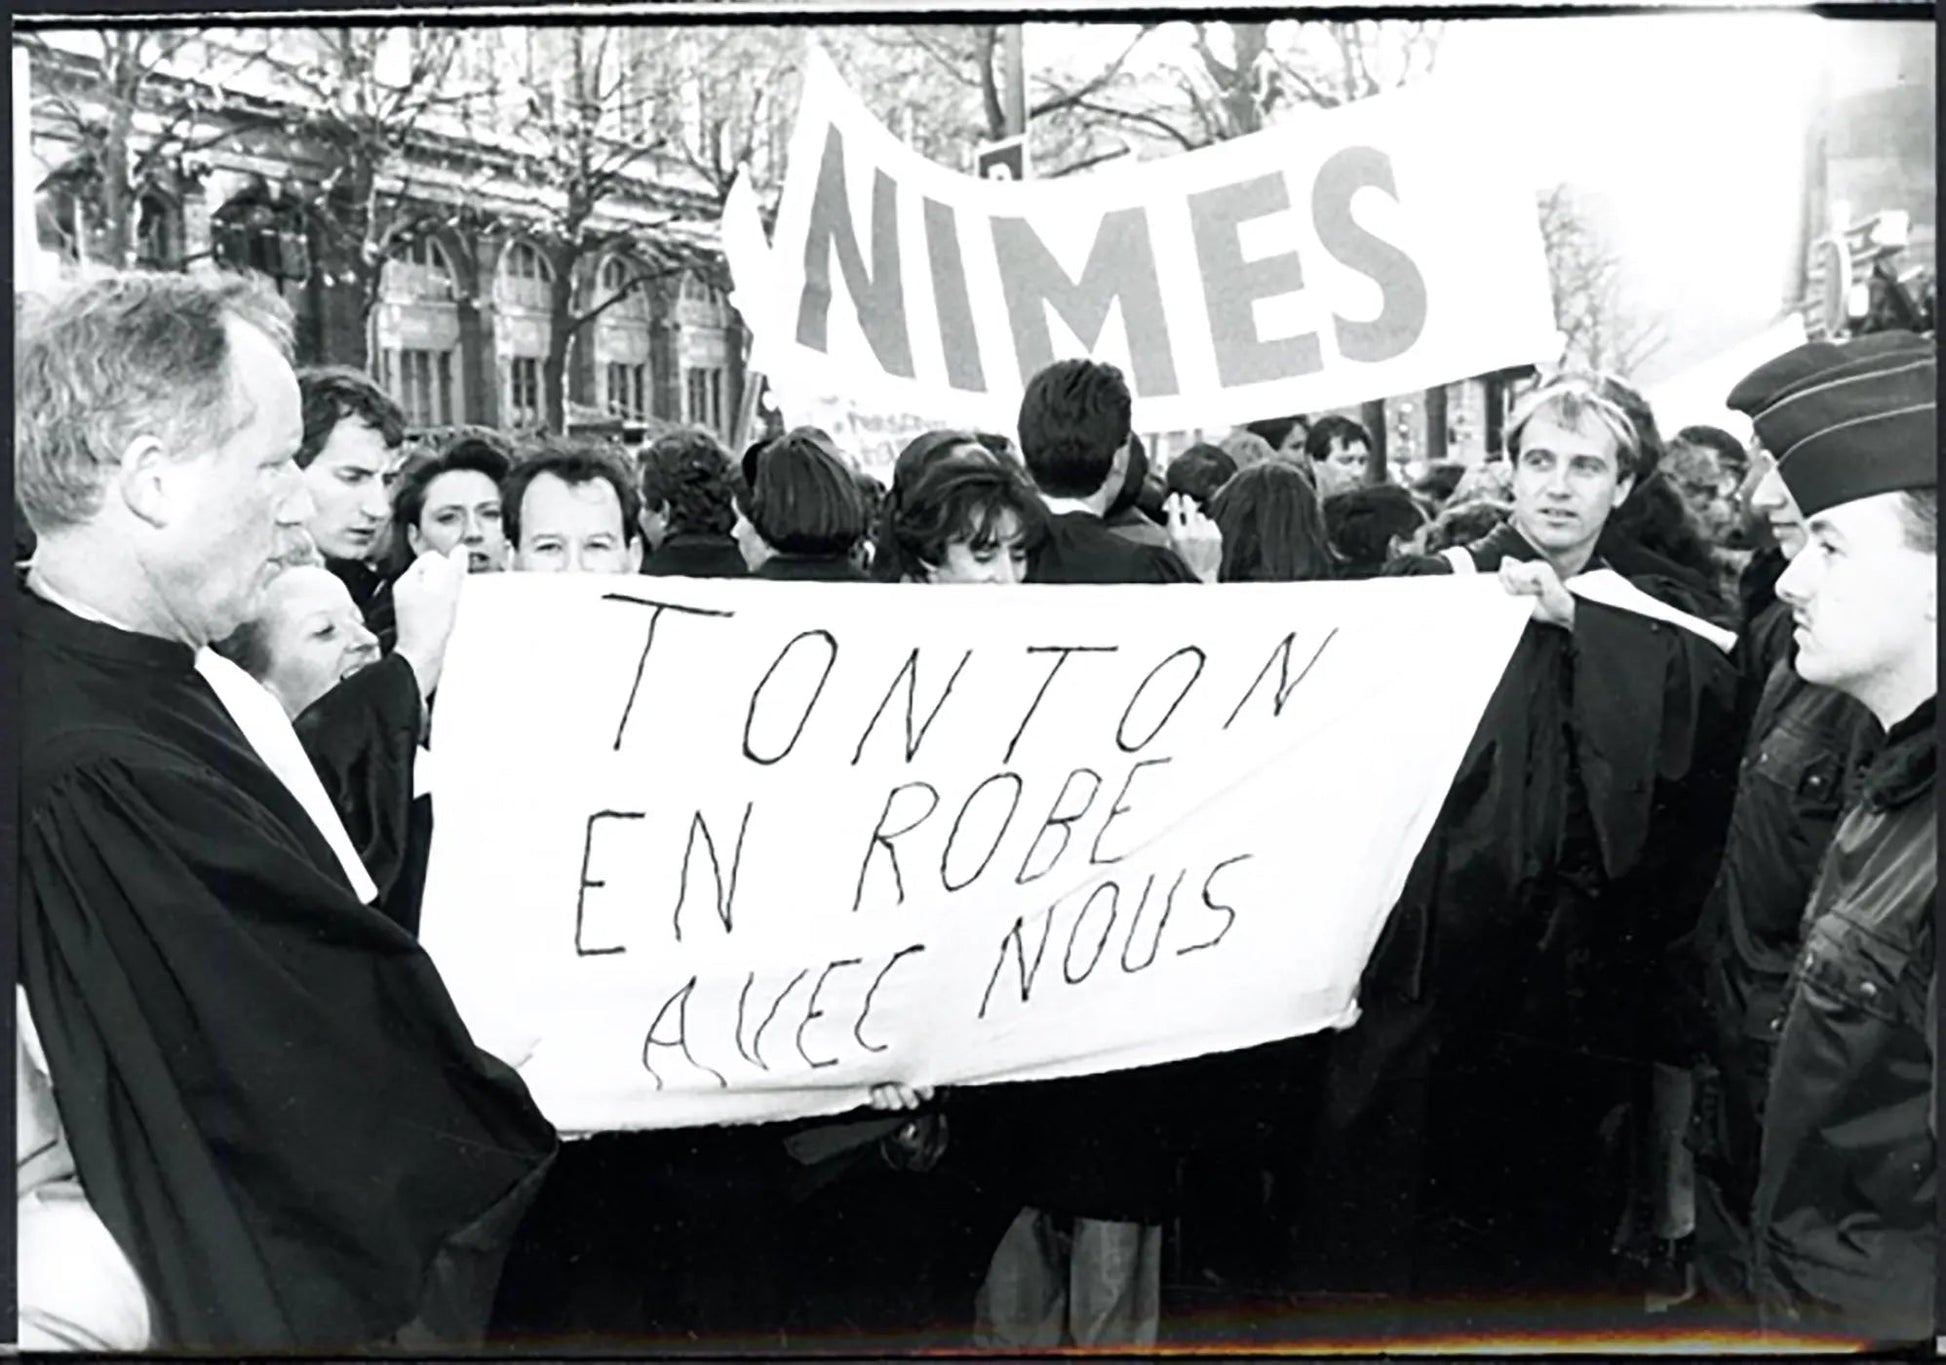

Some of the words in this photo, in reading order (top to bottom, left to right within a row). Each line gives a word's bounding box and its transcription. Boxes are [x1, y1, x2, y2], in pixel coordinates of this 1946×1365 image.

[794, 121, 1429, 397] NIMES
[601, 593, 1340, 766] TONTON
[575, 801, 753, 956] EN
[852, 757, 1173, 912] ROBE
[642, 944, 925, 1090] AVEC
[977, 853, 1254, 1019] NOUS
